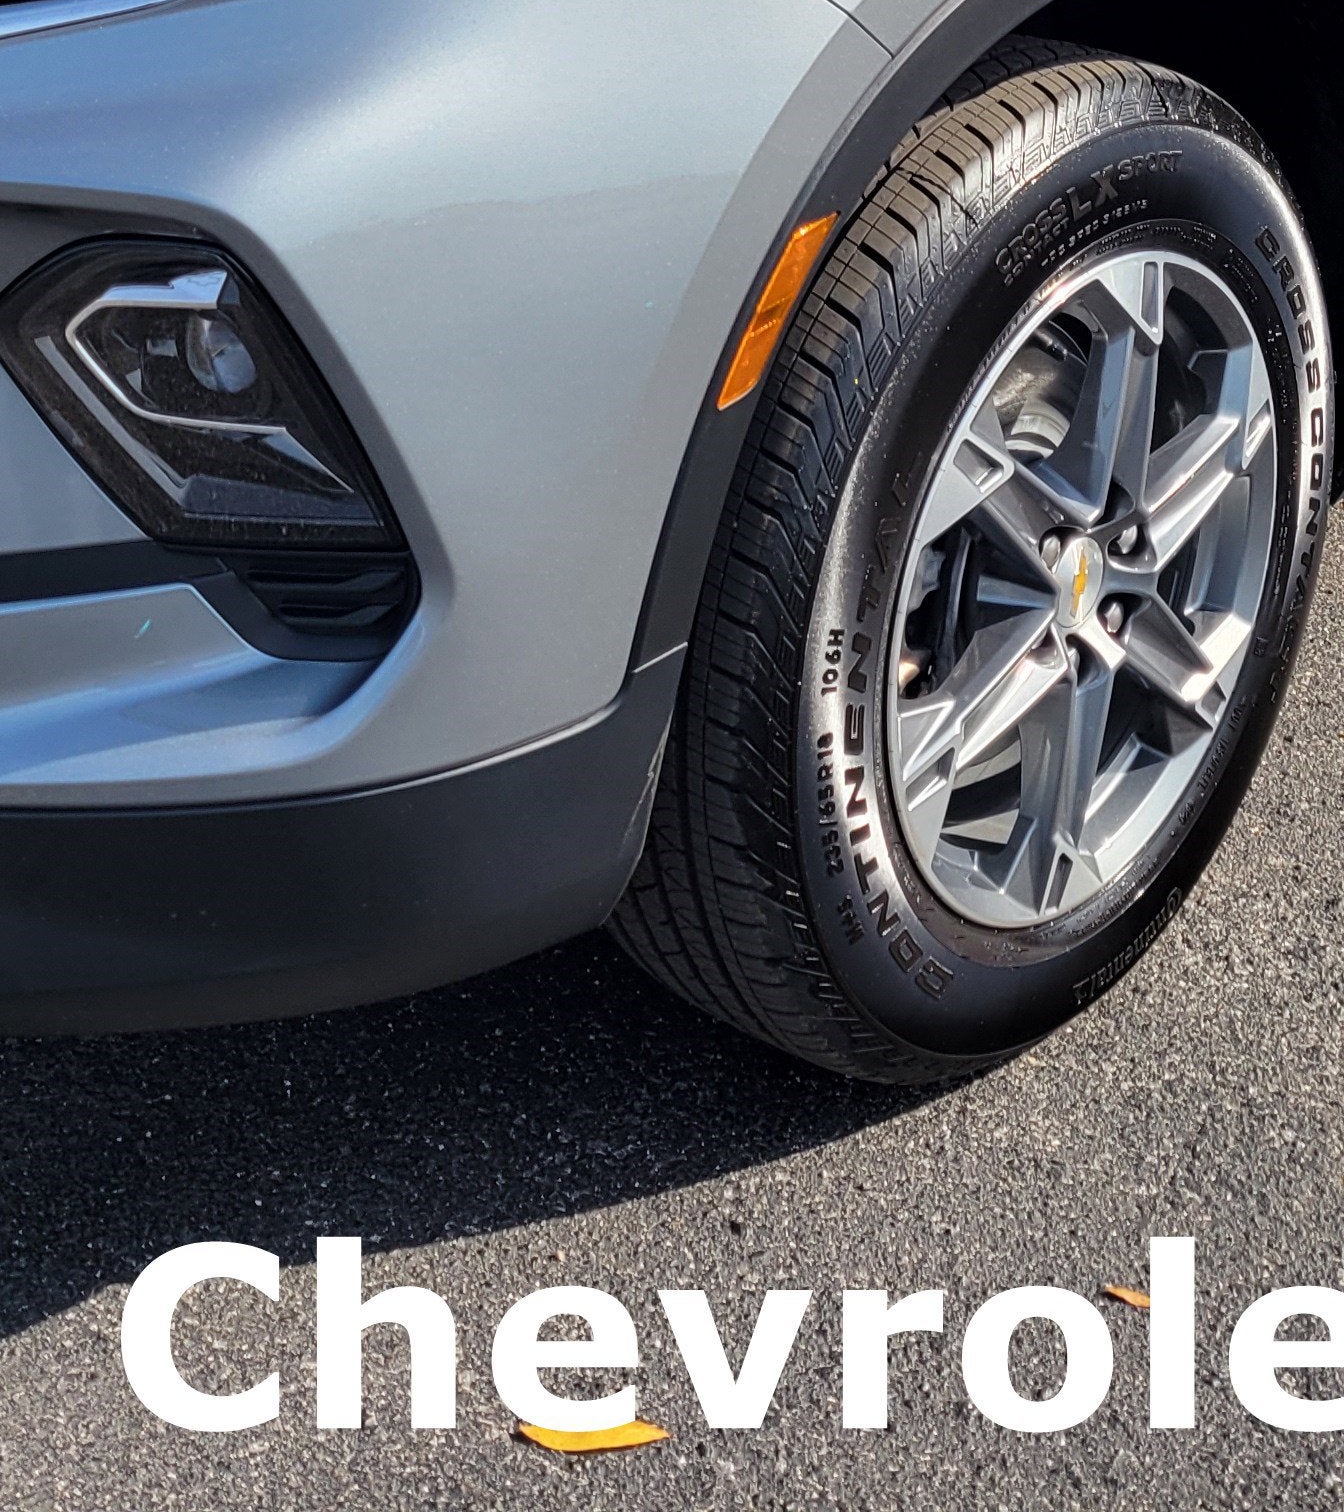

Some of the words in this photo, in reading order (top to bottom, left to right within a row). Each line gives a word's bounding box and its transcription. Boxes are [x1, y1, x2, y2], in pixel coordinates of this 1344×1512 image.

[1118, 149, 1183, 182] SPORT
[994, 197, 1068, 276] CROSS
[1254, 225, 1321, 394] CROSS
[820, 628, 846, 698] 106H
[843, 448, 954, 1000] CONTINENTAL
[817, 731, 845, 878] 235/65R18
